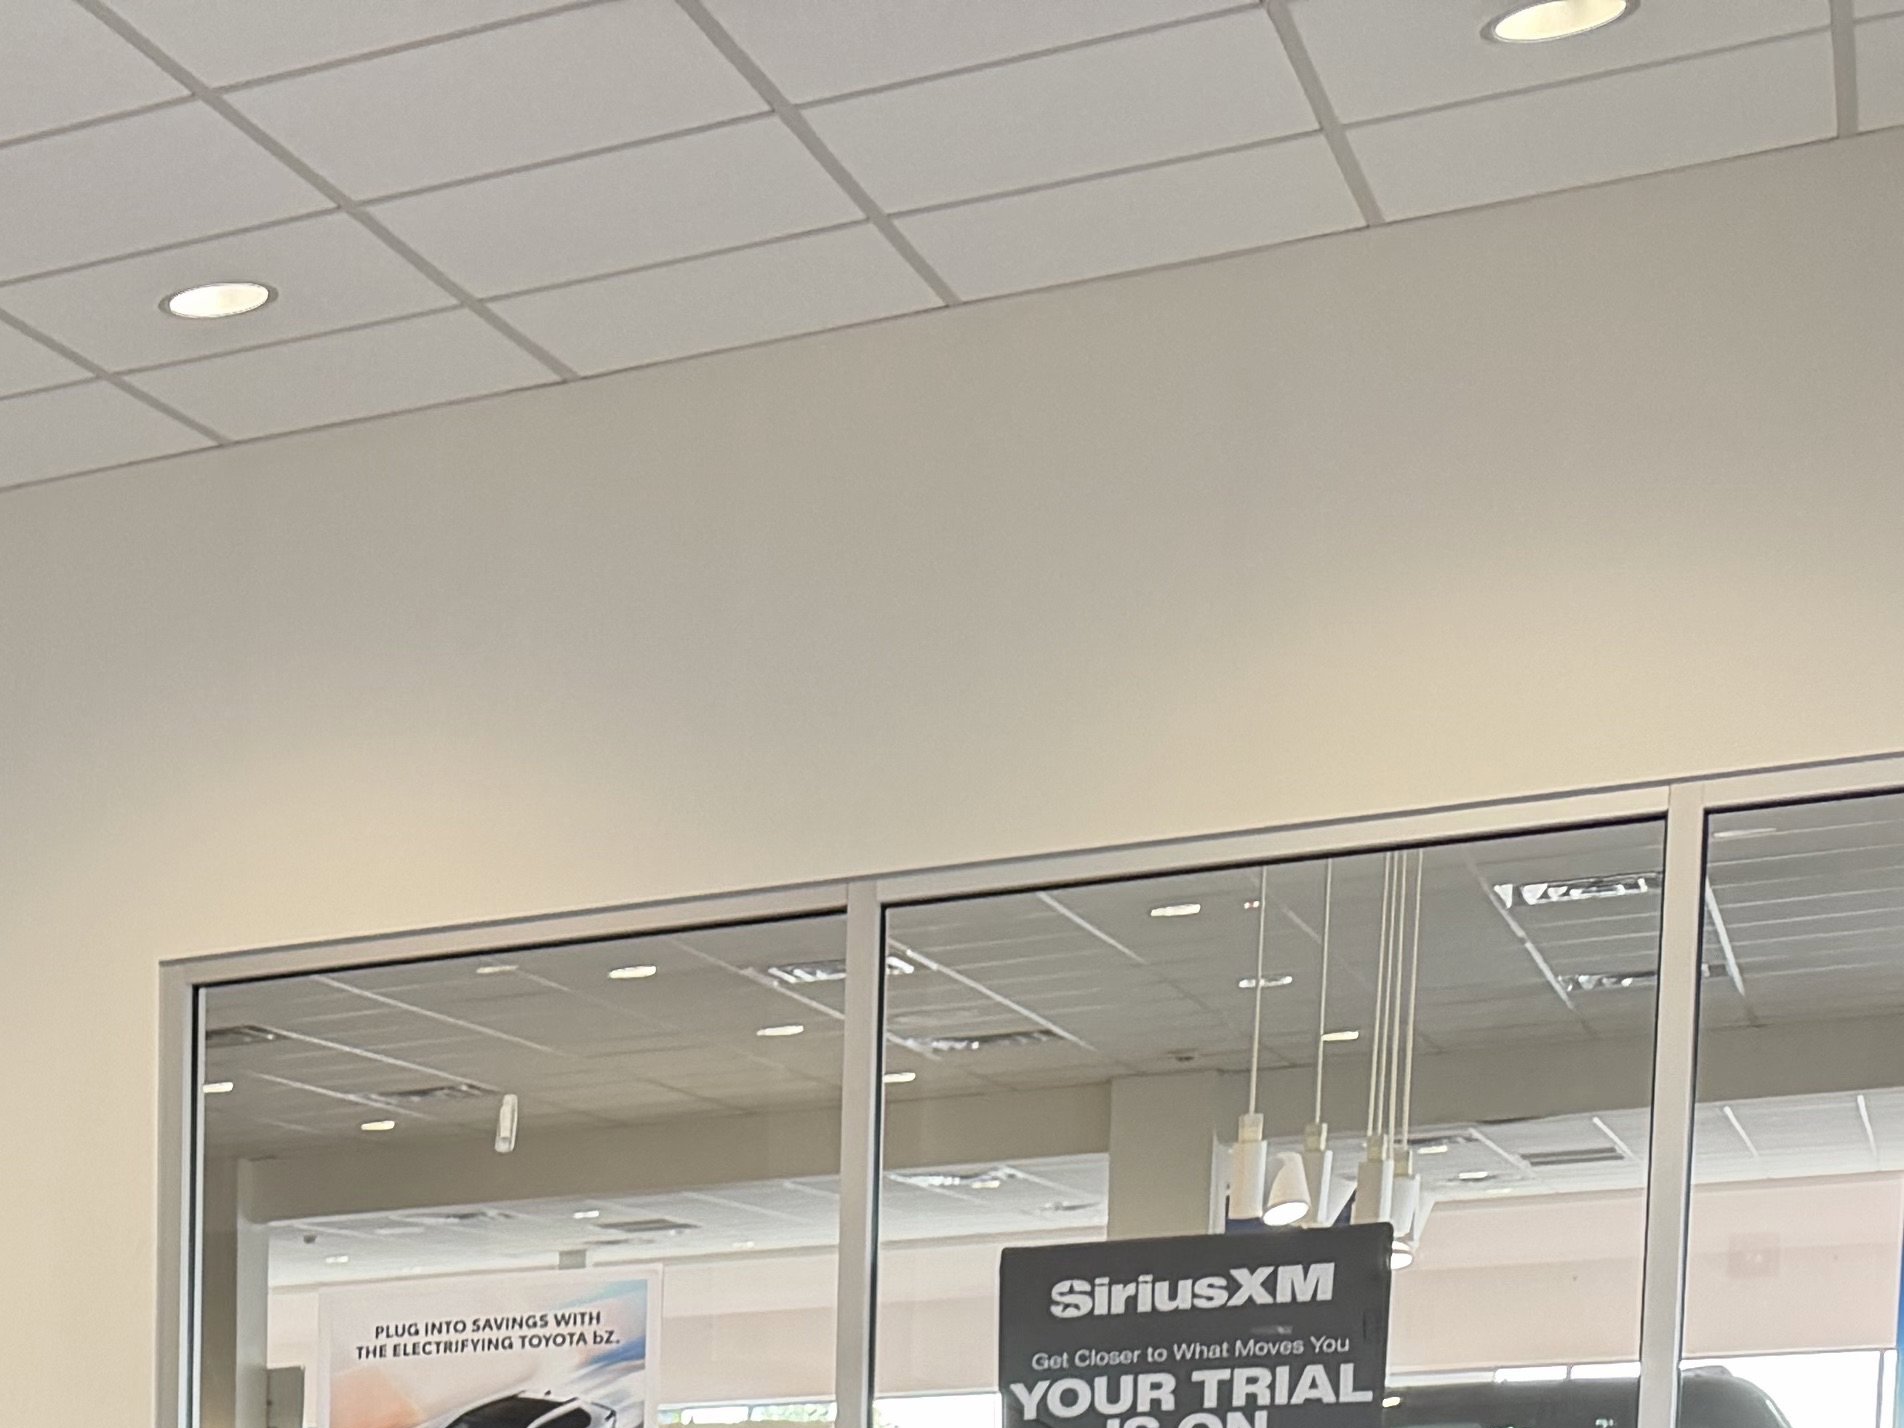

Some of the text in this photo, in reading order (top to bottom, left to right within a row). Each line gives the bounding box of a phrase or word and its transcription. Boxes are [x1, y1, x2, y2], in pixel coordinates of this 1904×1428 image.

[1049, 1262, 1336, 1319] SiriusXM
[375, 1311, 601, 1340] PLUG INTO SAVINGS WITH
[356, 1343, 387, 1360] THE
[392, 1336, 513, 1358] ELECTRIFYING
[519, 1331, 588, 1350] TOYOTA
[1032, 1335, 1350, 1371] Get Closer to What Moves You
[1010, 1362, 1373, 1420] YOUR TRIAL
